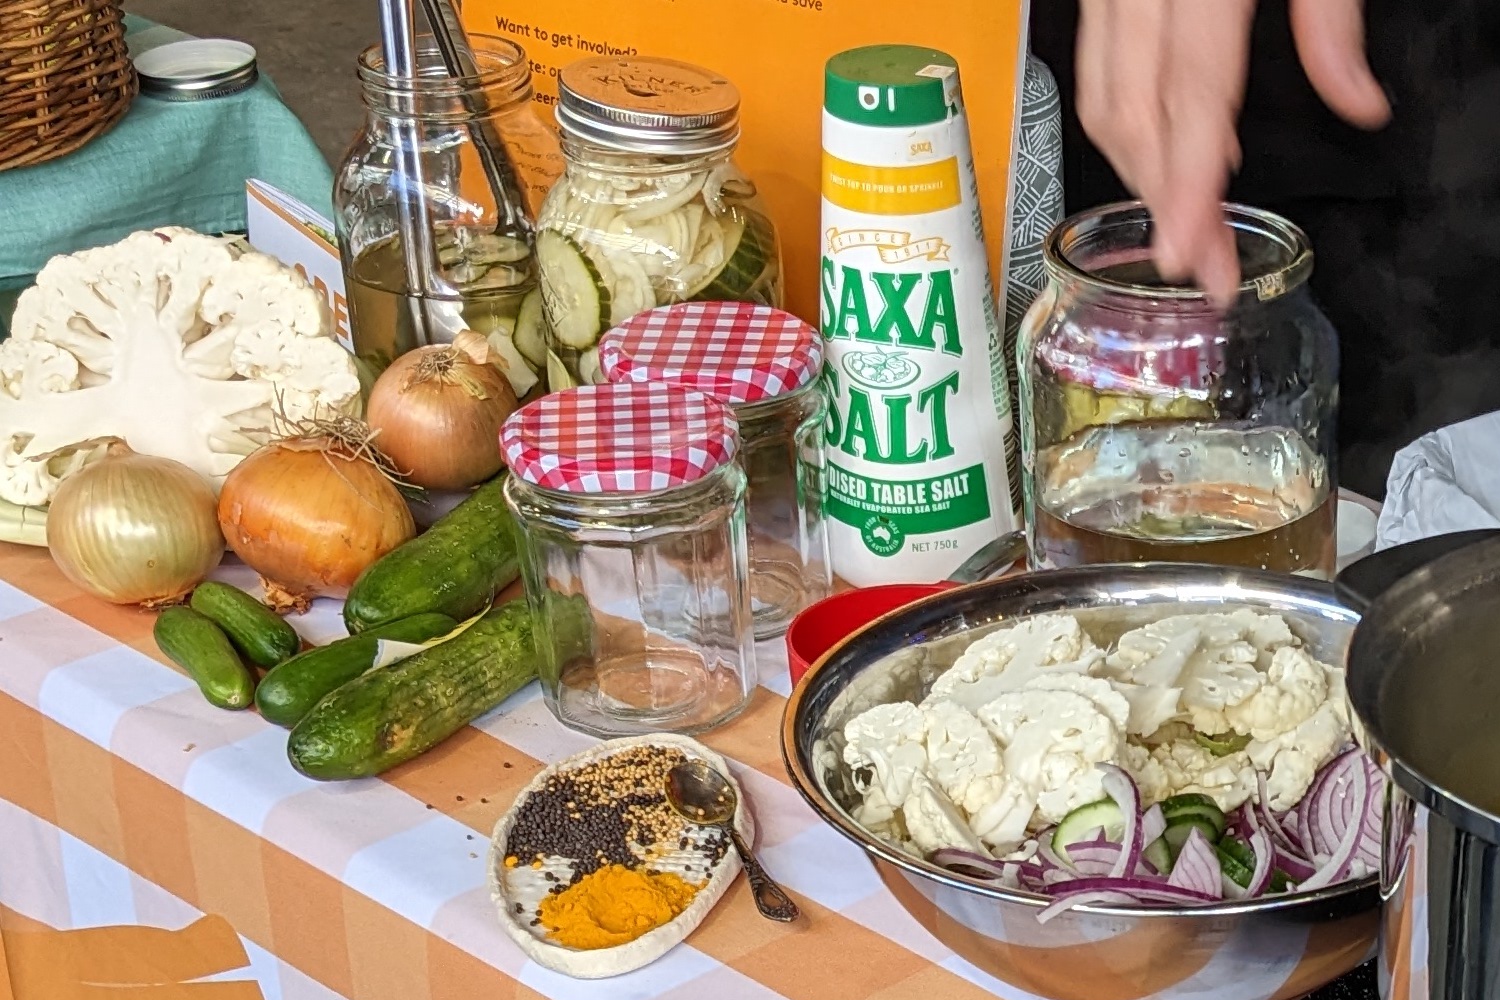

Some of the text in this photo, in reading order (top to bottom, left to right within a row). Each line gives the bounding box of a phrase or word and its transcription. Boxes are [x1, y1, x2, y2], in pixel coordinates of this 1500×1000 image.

[495, 15, 530, 37] Want
[534, 26, 548, 41] to
[551, 33, 574, 49] get
[873, 184, 895, 194] POUR
[897, 184, 907, 194] OR
[838, 232, 897, 246] SINCE
[893, 242, 931, 260] 1911
[822, 255, 964, 359] SAXA
[822, 357, 961, 466] SALT
[870, 482, 927, 506] TABLE
[931, 472, 971, 500] SALT
[862, 501, 913, 516] EVAPORATED
[914, 505, 931, 515] SEA
[932, 500, 951, 513] SALT
[911, 543, 931, 553] NET
